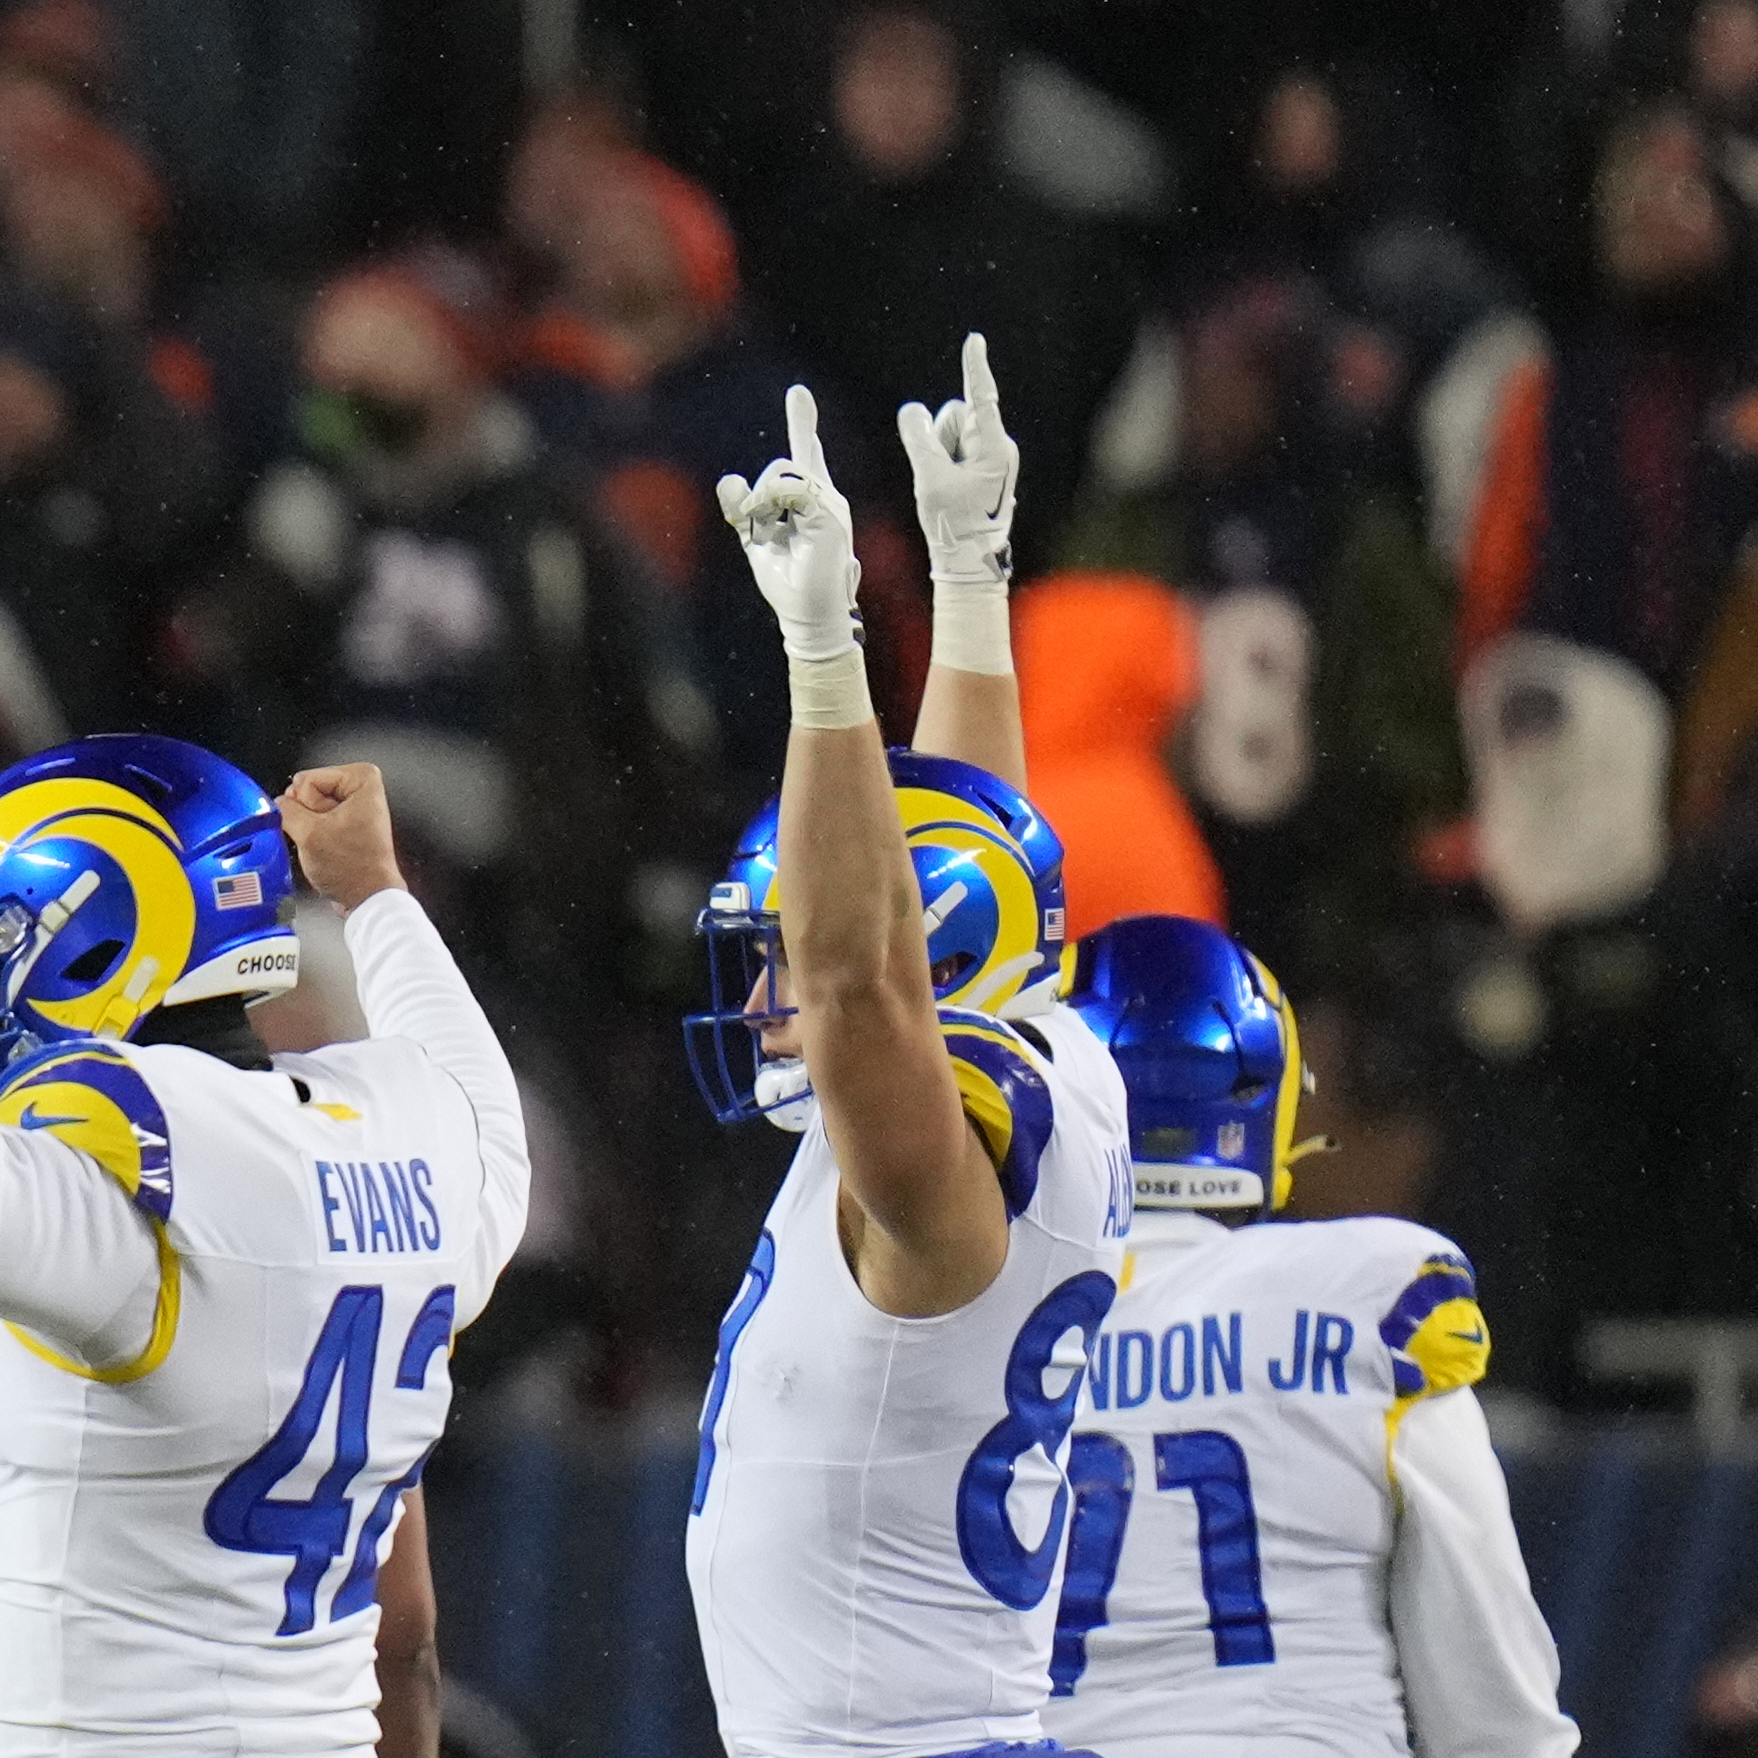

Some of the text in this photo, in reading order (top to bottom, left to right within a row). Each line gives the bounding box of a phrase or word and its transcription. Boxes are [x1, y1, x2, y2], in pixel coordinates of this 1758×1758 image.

[315, 1158, 441, 1253] EVANS
[202, 1284, 456, 1637] 42
[955, 1268, 1118, 1612] 8
[1268, 1308, 1356, 1396] JR
